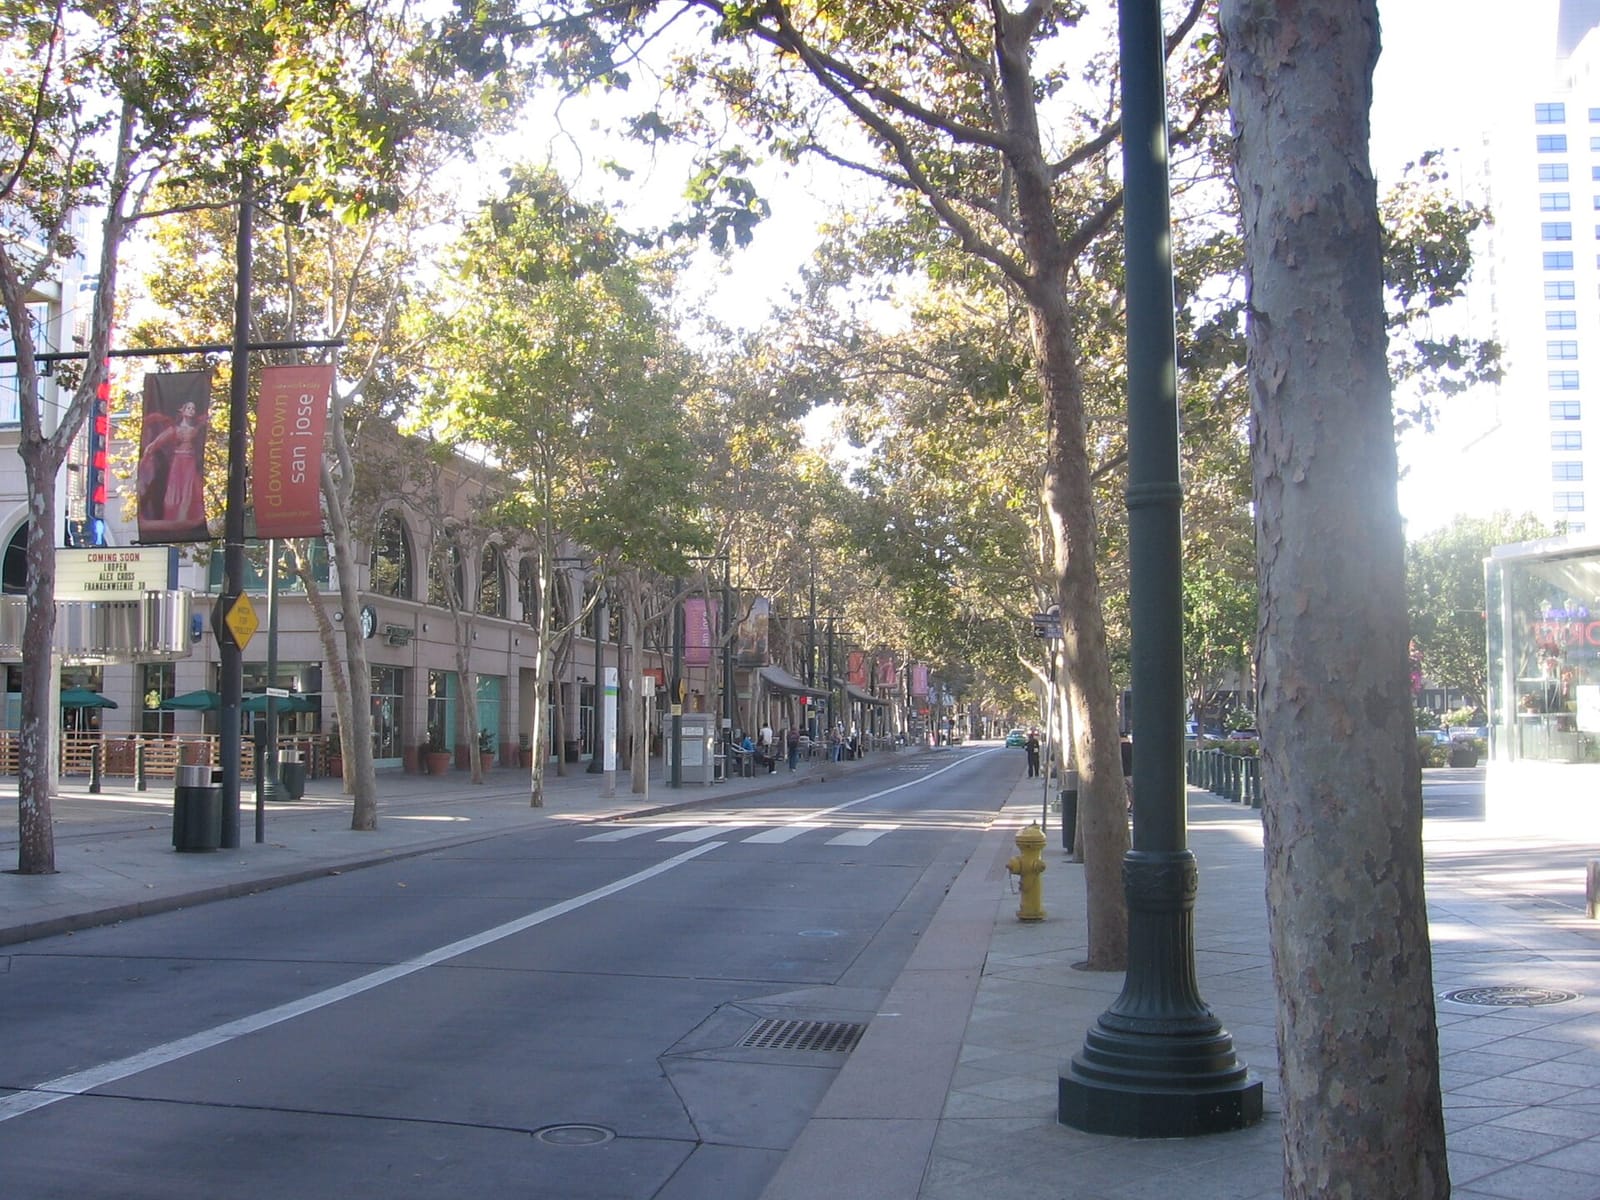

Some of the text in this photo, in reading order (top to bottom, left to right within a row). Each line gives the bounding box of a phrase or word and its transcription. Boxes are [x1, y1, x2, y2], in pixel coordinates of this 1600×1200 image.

[290, 394, 314, 436] jose
[265, 394, 289, 507] downtown
[291, 446, 308, 484] san
[87, 552, 140, 562] COMING SOON
[103, 562, 128, 572] LOOPER
[99, 572, 135, 581] ALEX CROSS
[84, 582, 133, 591] FRANKENWEENIE
